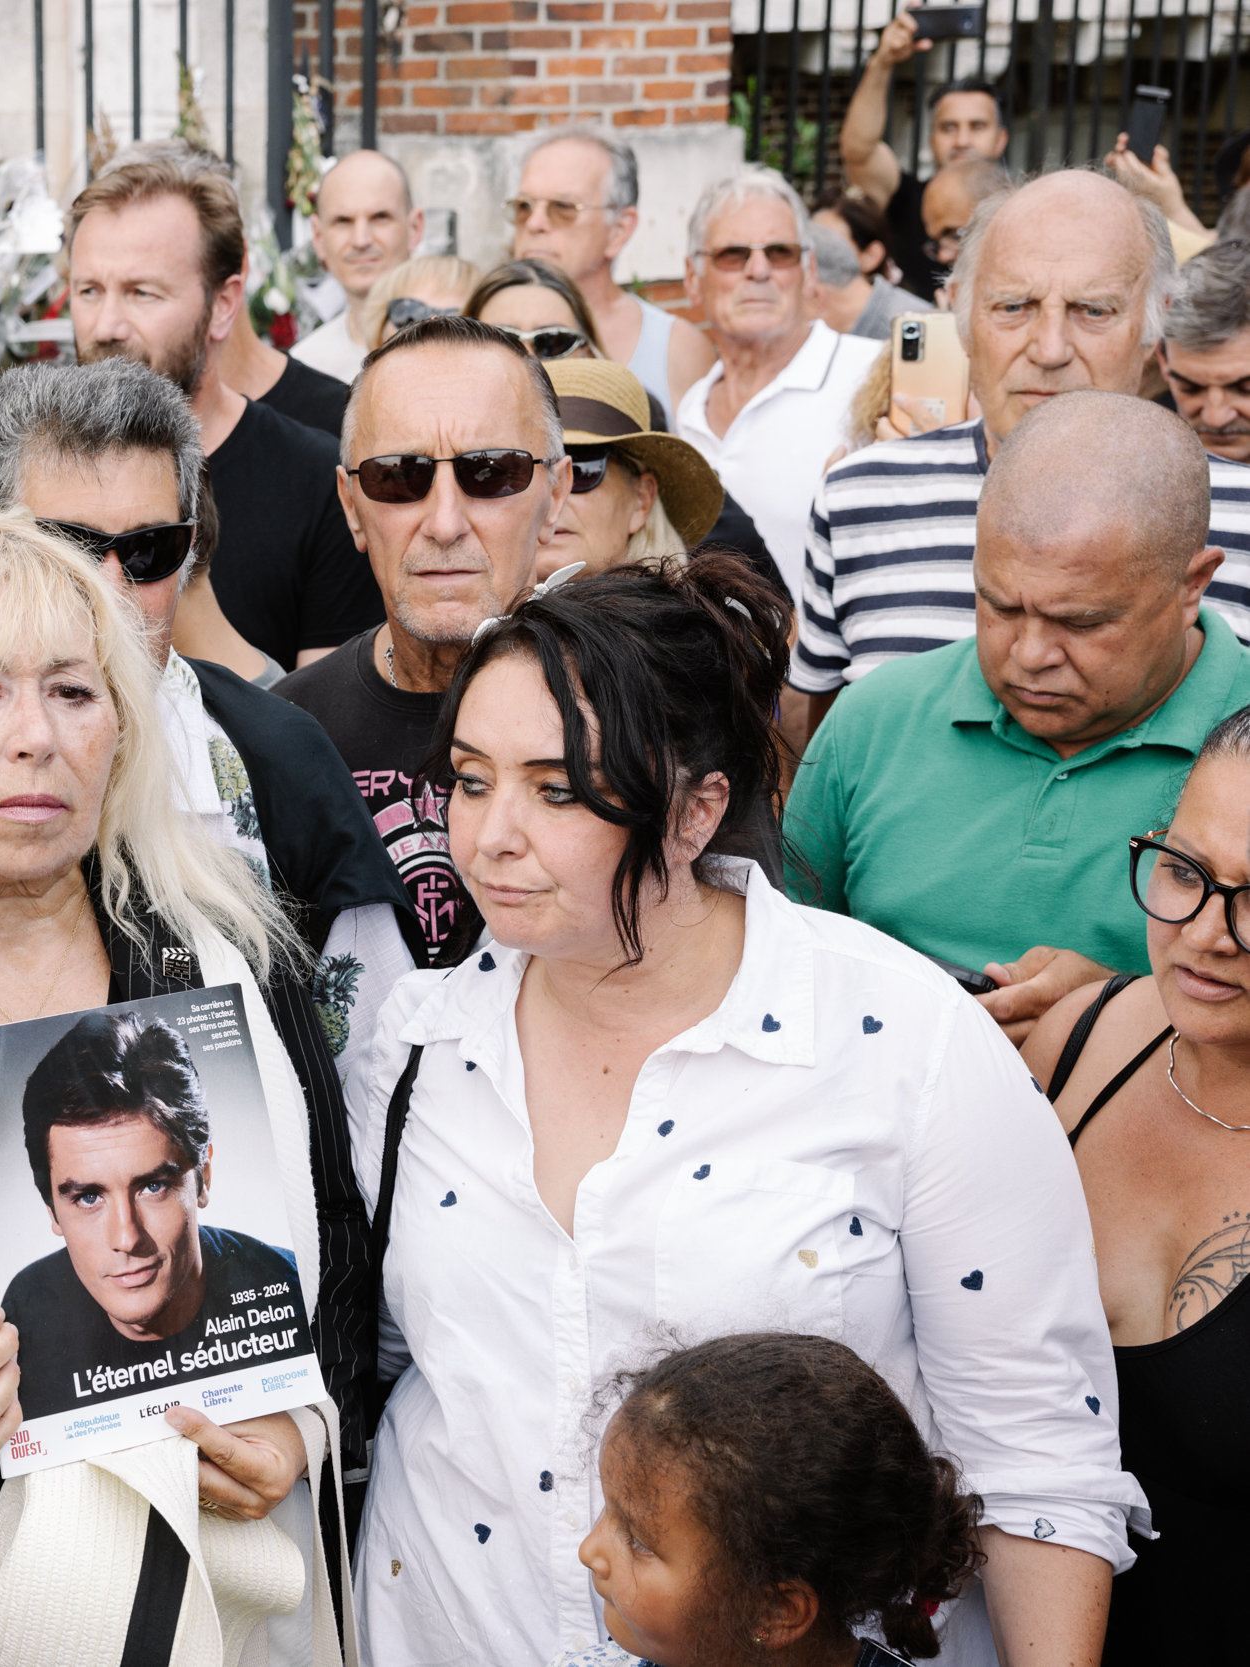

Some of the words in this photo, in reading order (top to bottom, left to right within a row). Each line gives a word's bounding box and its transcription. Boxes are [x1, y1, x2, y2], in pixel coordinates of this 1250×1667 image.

[191, 1004, 200, 1012] Sa
[200, 1000, 225, 1012] carrière
[176, 1016, 186, 1026] 23
[186, 1014, 208, 1026] photos
[211, 1009, 236, 1020] l'acteur,
[188, 1026, 200, 1034] ses
[200, 1023, 217, 1032] films
[217, 1019, 239, 1029] cultes,
[211, 1032, 223, 1040] ses
[223, 1028, 241, 1038] amis,
[202, 1044, 214, 1052] ses
[214, 1038, 242, 1050] passions
[230, 1288, 257, 1305] 1935
[262, 1281, 290, 1298] 2024
[204, 1313, 246, 1337] Alain
[246, 1304, 296, 1327] Delon
[72, 1349, 178, 1399] L'éternel
[180, 1326, 299, 1372] séducteur
[261, 1368, 310, 1386] DORDOGNE
[201, 1383, 244, 1400] Charente
[203, 1395, 228, 1408] Libre
[64, 1424, 73, 1433] La
[73, 1412, 121, 1431] République
[74, 1429, 88, 1438] des
[87, 1421, 123, 1437] Pyrénées
[10, 1429, 30, 1445] SUD
[11, 1441, 42, 1460] OUEST
